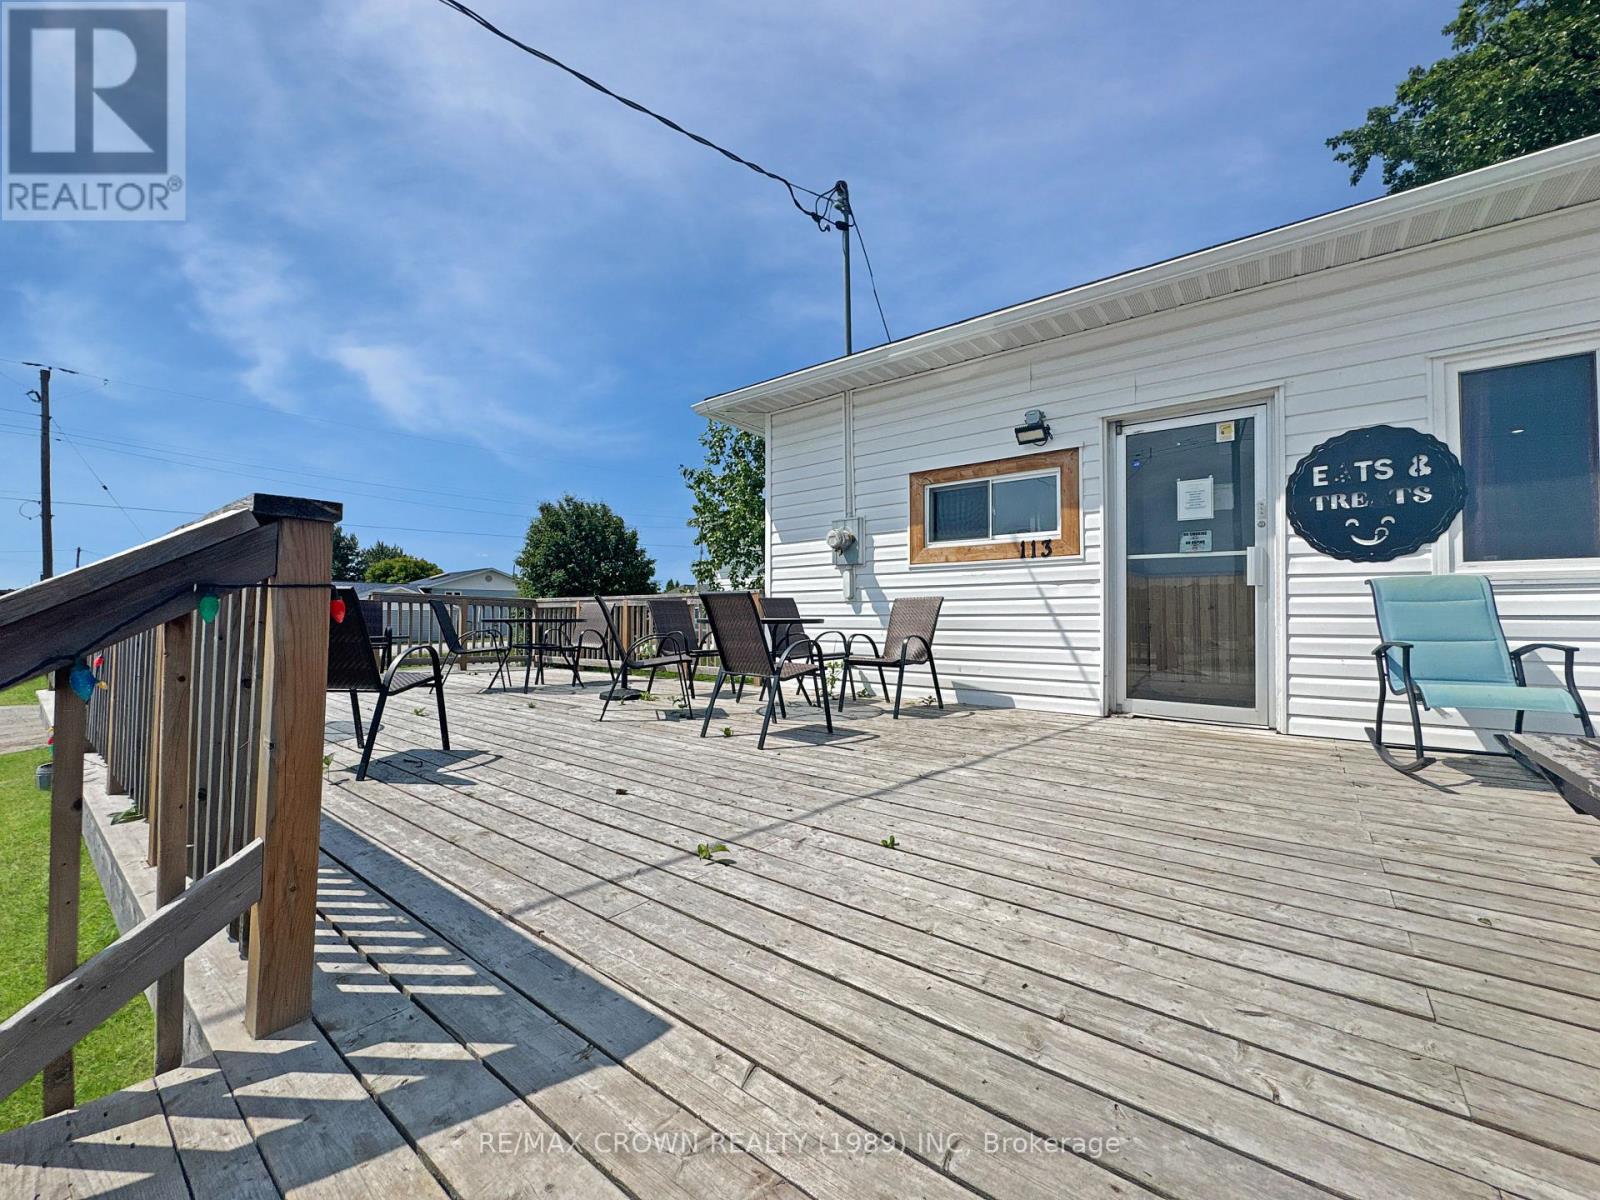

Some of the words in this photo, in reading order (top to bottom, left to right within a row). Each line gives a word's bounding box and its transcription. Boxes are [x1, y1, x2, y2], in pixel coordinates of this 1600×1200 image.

[1408, 454, 1433, 478] &
[1309, 486, 1433, 512] TRETS
[1020, 539, 1052, 559] 113
